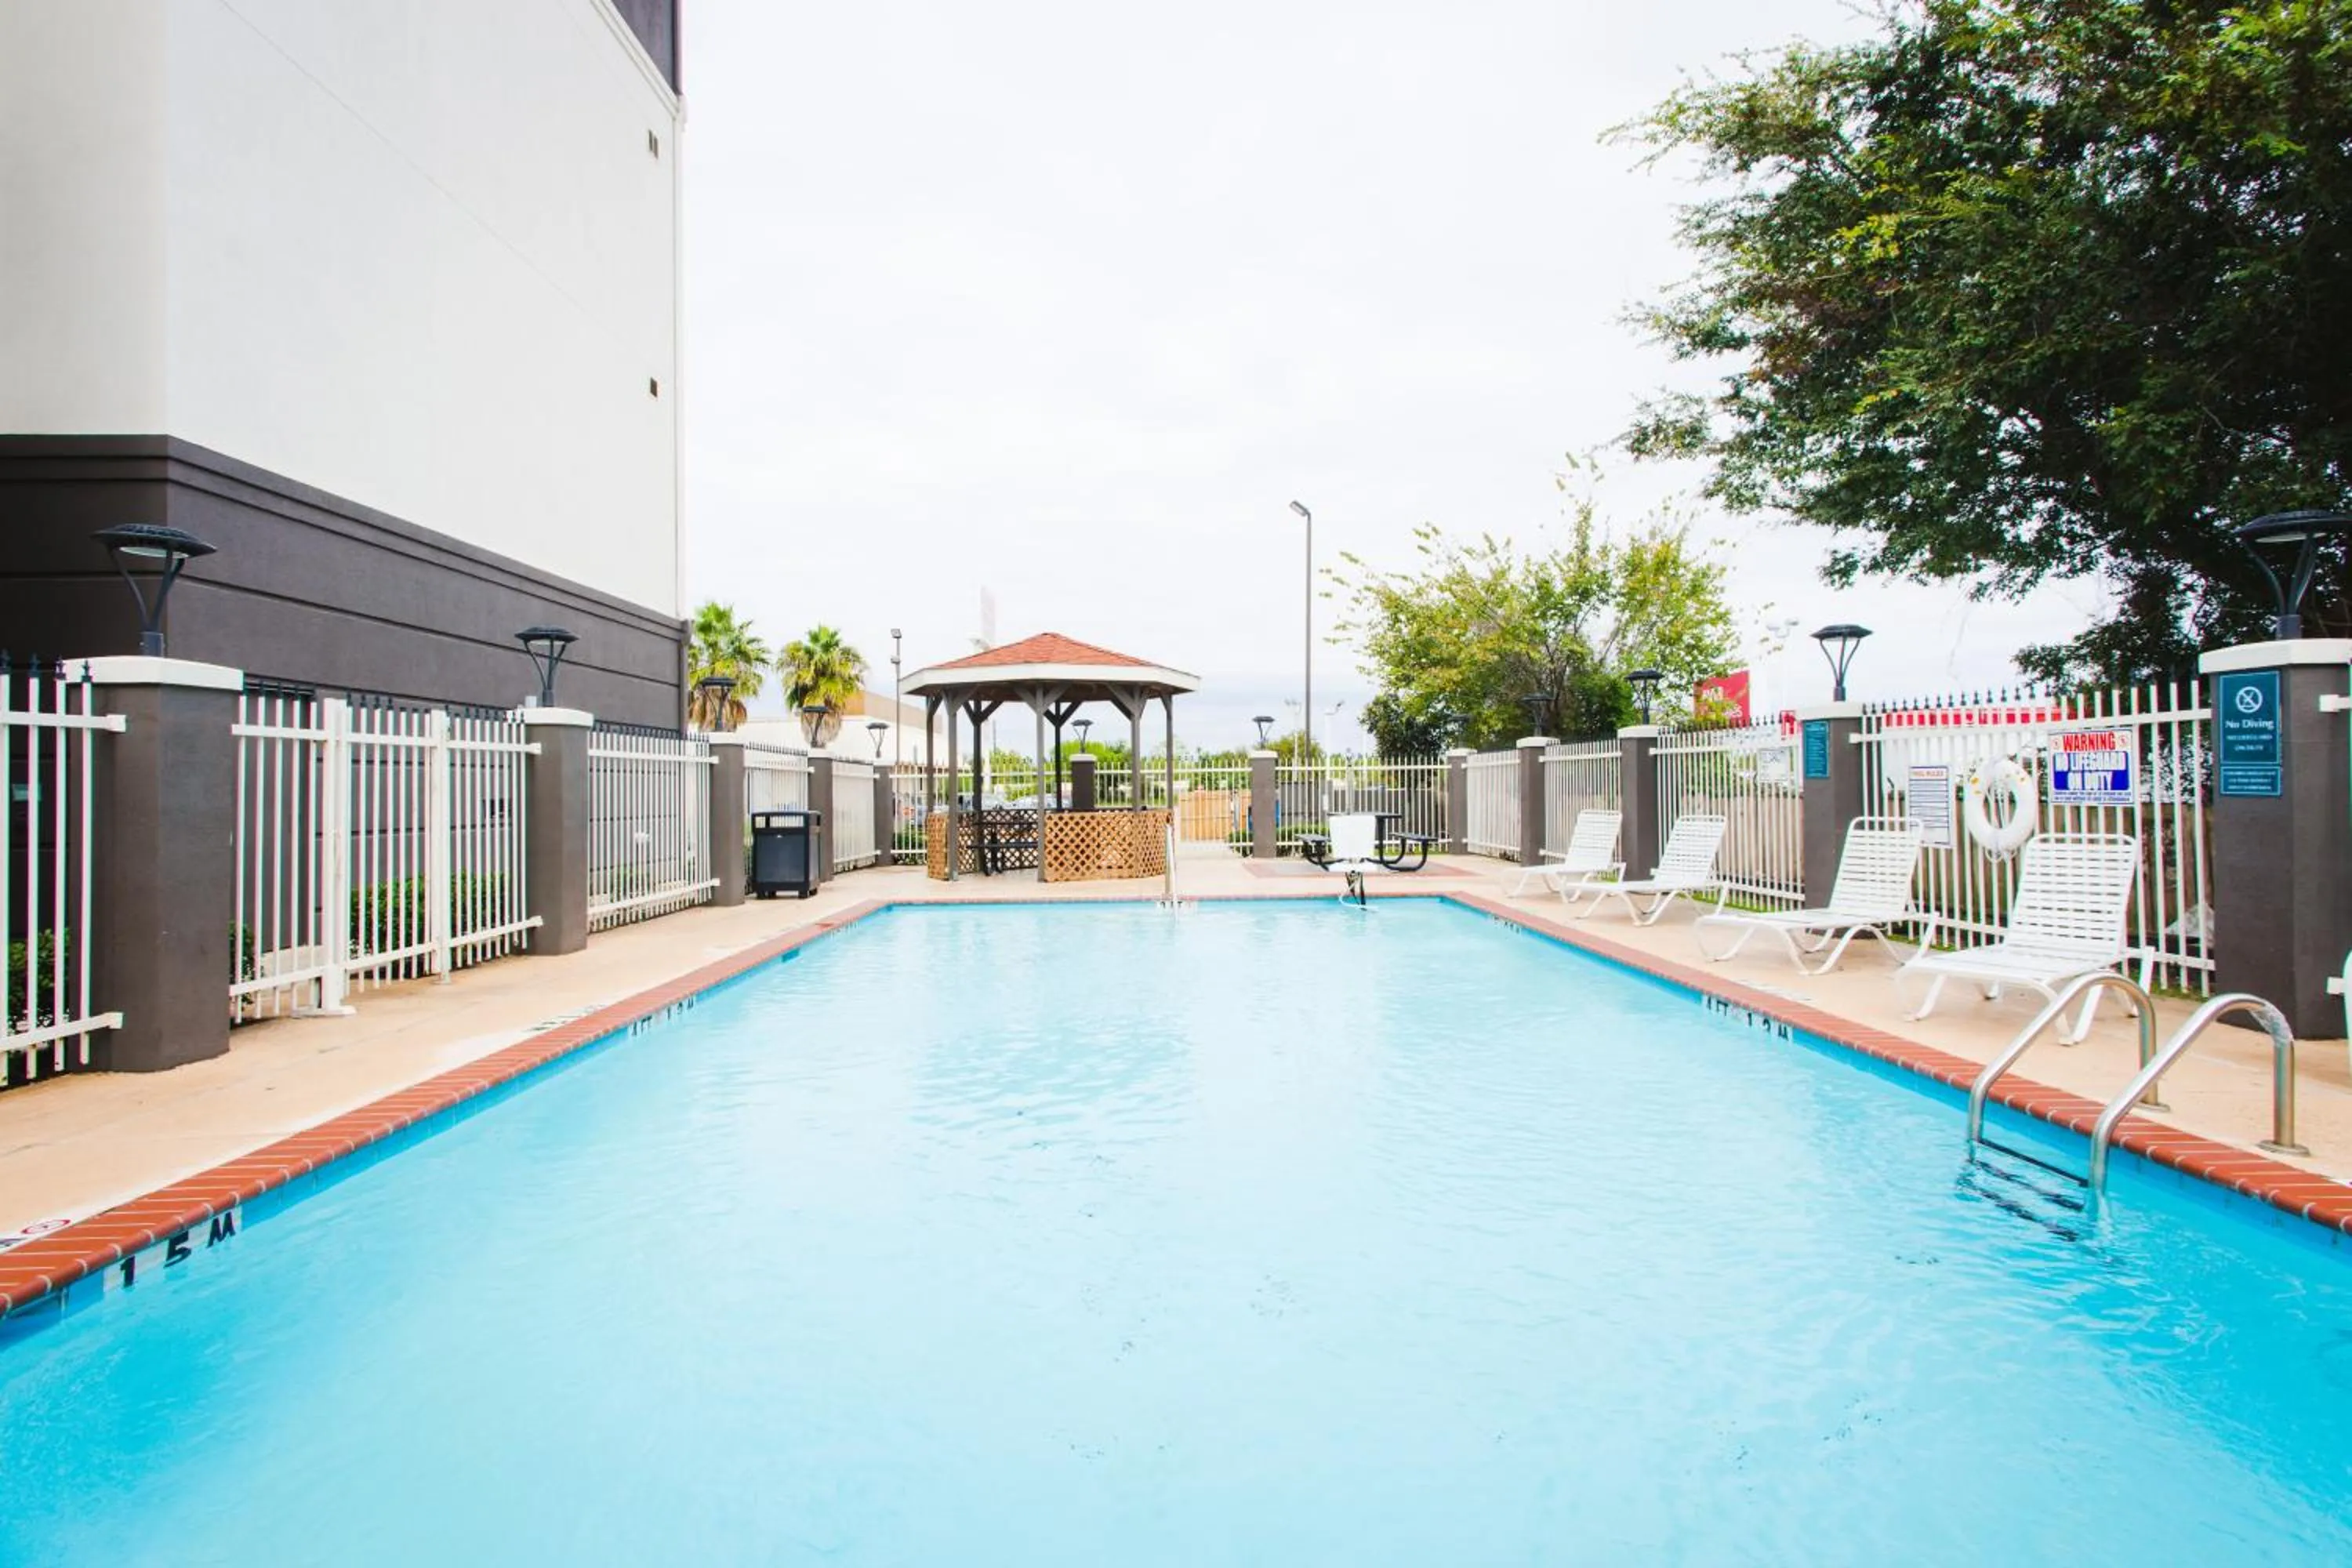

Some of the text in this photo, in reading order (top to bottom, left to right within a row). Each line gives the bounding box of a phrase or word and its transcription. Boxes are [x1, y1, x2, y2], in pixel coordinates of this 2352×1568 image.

[2225, 719, 2274, 730] No Diving
[2063, 731, 2115, 751] WARNING
[2070, 751, 2126, 771] LIFEGUARD
[2067, 771, 2114, 791] ON DUTY
[119, 1210, 237, 1288] 1 5 M
